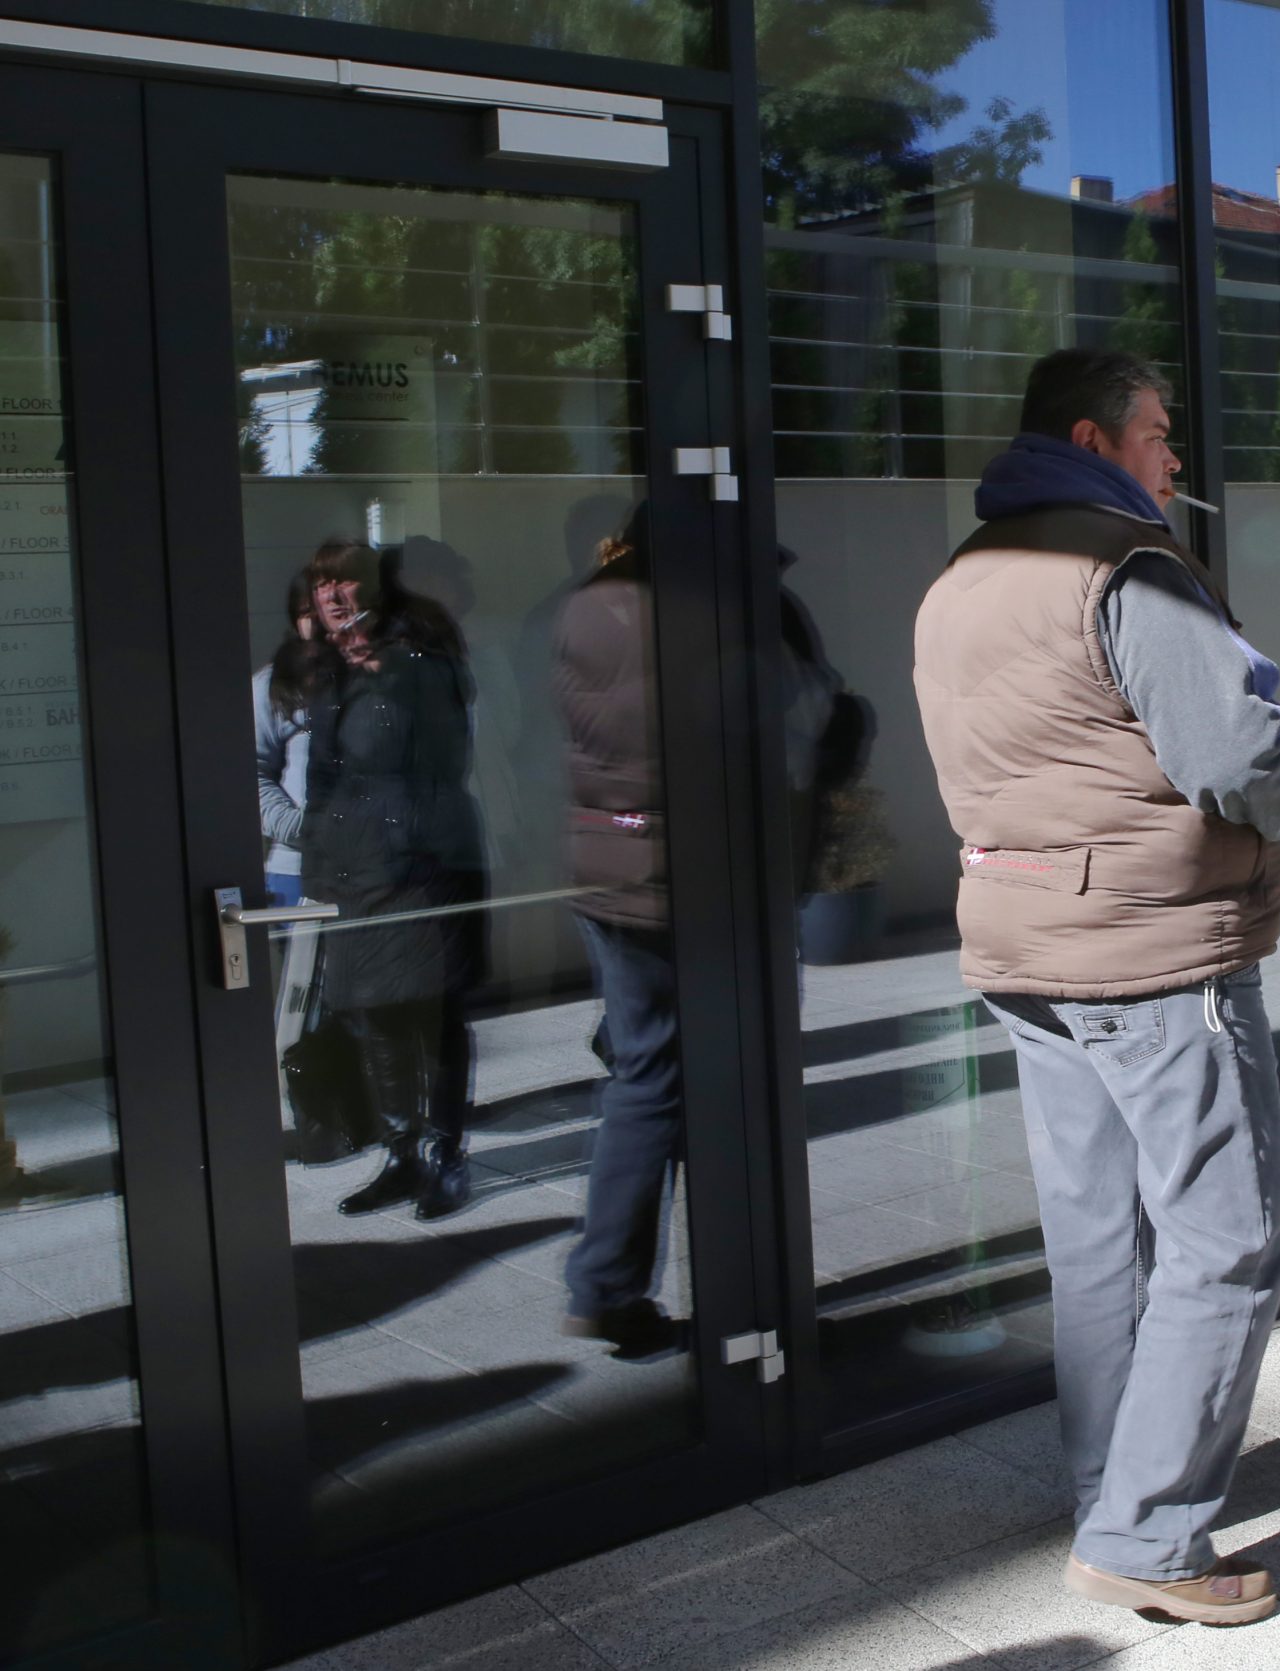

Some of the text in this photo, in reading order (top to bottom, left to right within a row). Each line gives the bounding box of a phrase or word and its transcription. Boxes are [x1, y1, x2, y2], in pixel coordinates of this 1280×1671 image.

[2, 397, 53, 411] FLOOR
[6, 467, 56, 480] FLOOR
[10, 536, 60, 549] FLOOR
[14, 606, 63, 619] FLOOR
[18, 675, 67, 689] FLOOR
[23, 744, 72, 759] FLOOR
